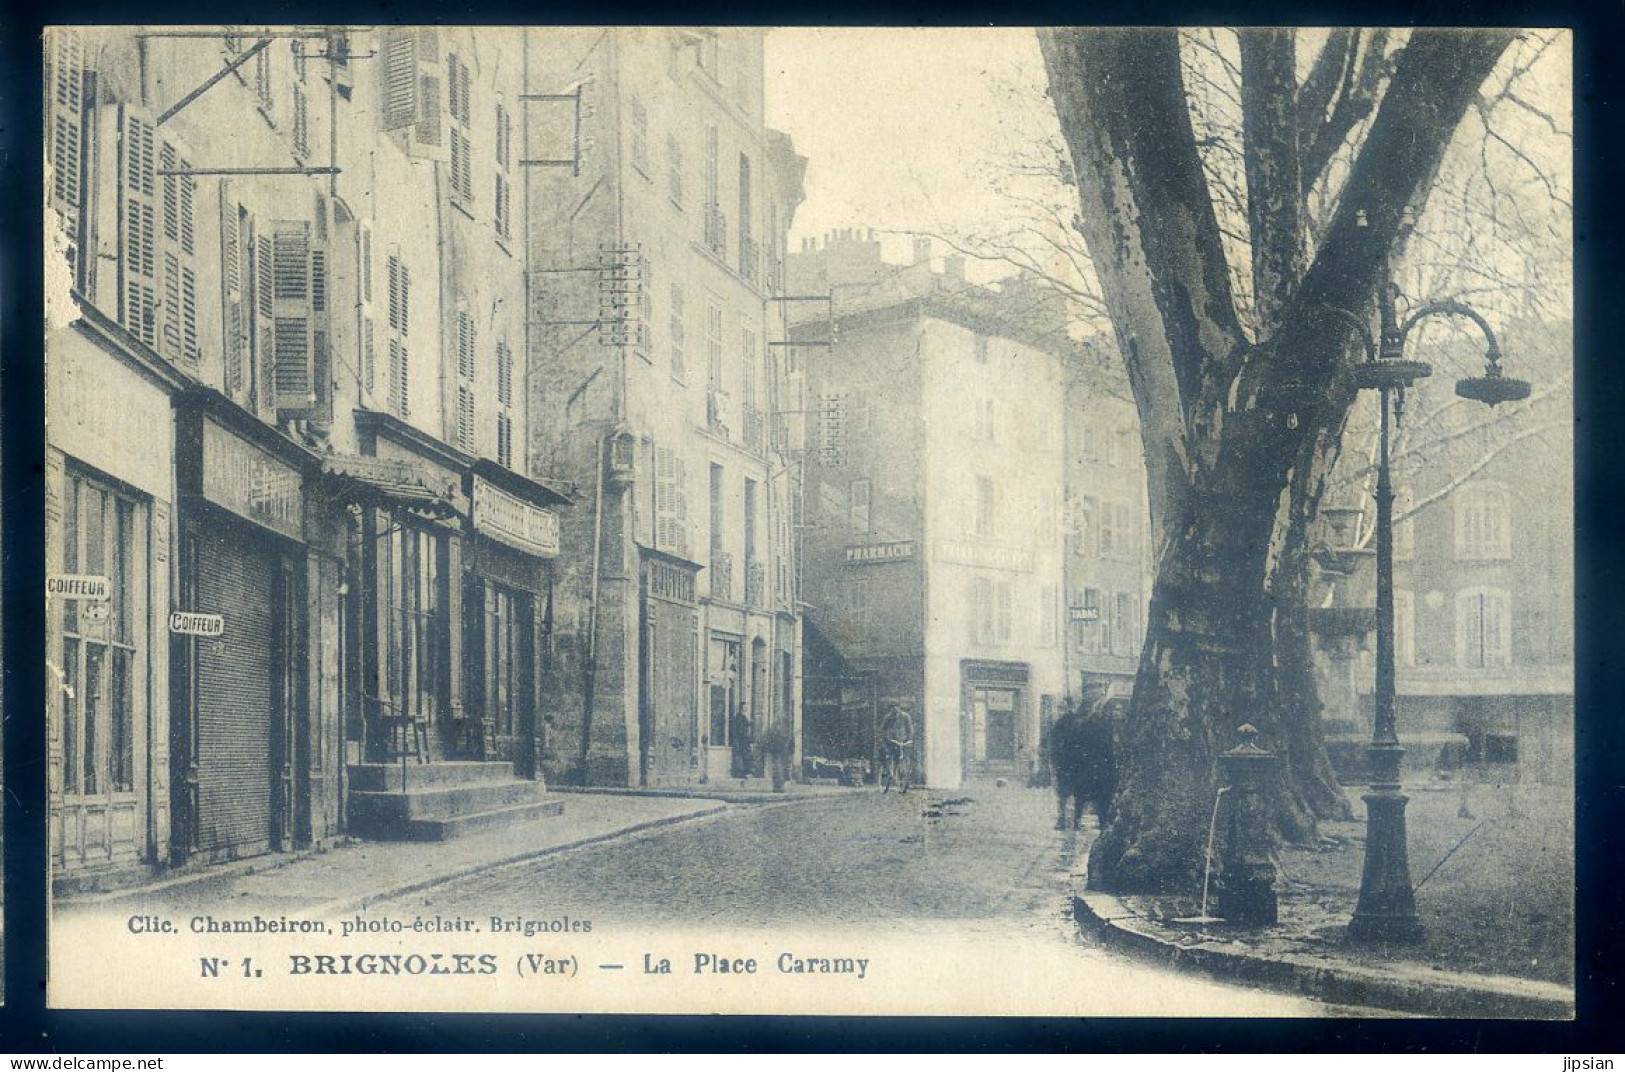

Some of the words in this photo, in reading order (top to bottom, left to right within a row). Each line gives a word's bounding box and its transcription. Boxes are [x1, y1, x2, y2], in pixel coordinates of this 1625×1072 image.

[846, 544, 914, 562] PHARMACIE
[47, 577, 105, 596] COIFFEUR
[489, 916, 592, 937] Brignoles
[289, 953, 498, 975] BRIGNOLES
[516, 953, 579, 978] (Var)
[643, 953, 672, 974] La
[693, 952, 758, 974] Place
[777, 952, 870, 979] Caramy
